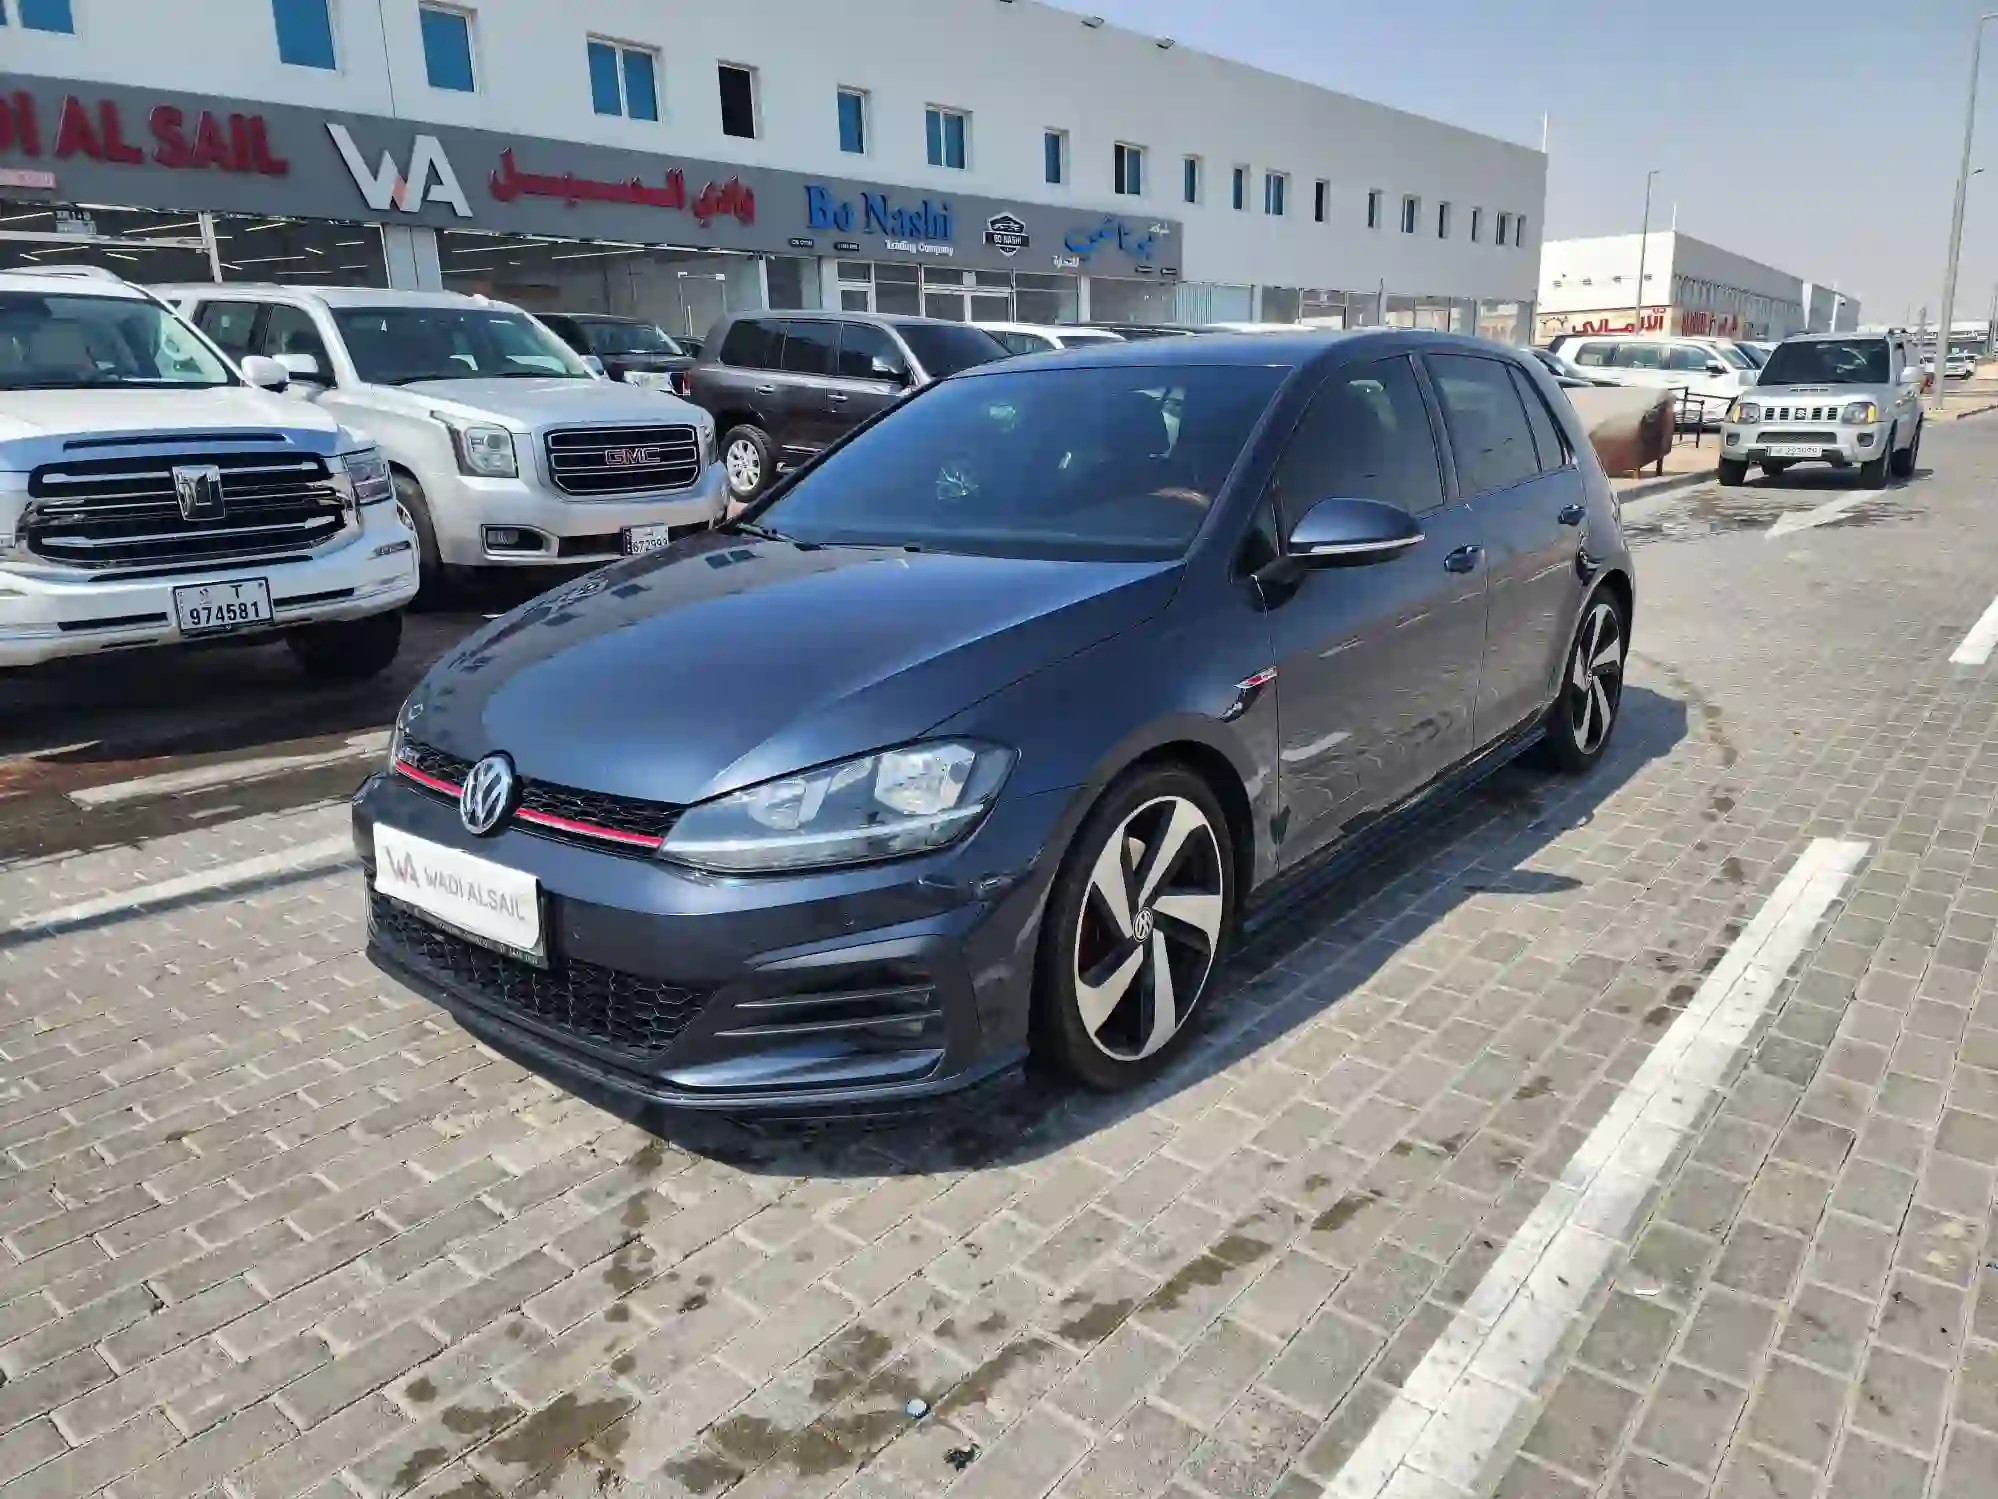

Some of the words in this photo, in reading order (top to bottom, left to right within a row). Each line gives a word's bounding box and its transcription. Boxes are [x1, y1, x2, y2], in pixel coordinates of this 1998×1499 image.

[55, 94, 144, 165] AL
[149, 105, 290, 176] SAIL
[325, 122, 473, 217] WA
[804, 185, 855, 232] Bo
[860, 192, 953, 240] Nashi
[604, 447, 661, 465] GMC
[229, 584, 243, 599] T
[189, 600, 260, 625] 974581
[424, 867, 464, 899] WADI
